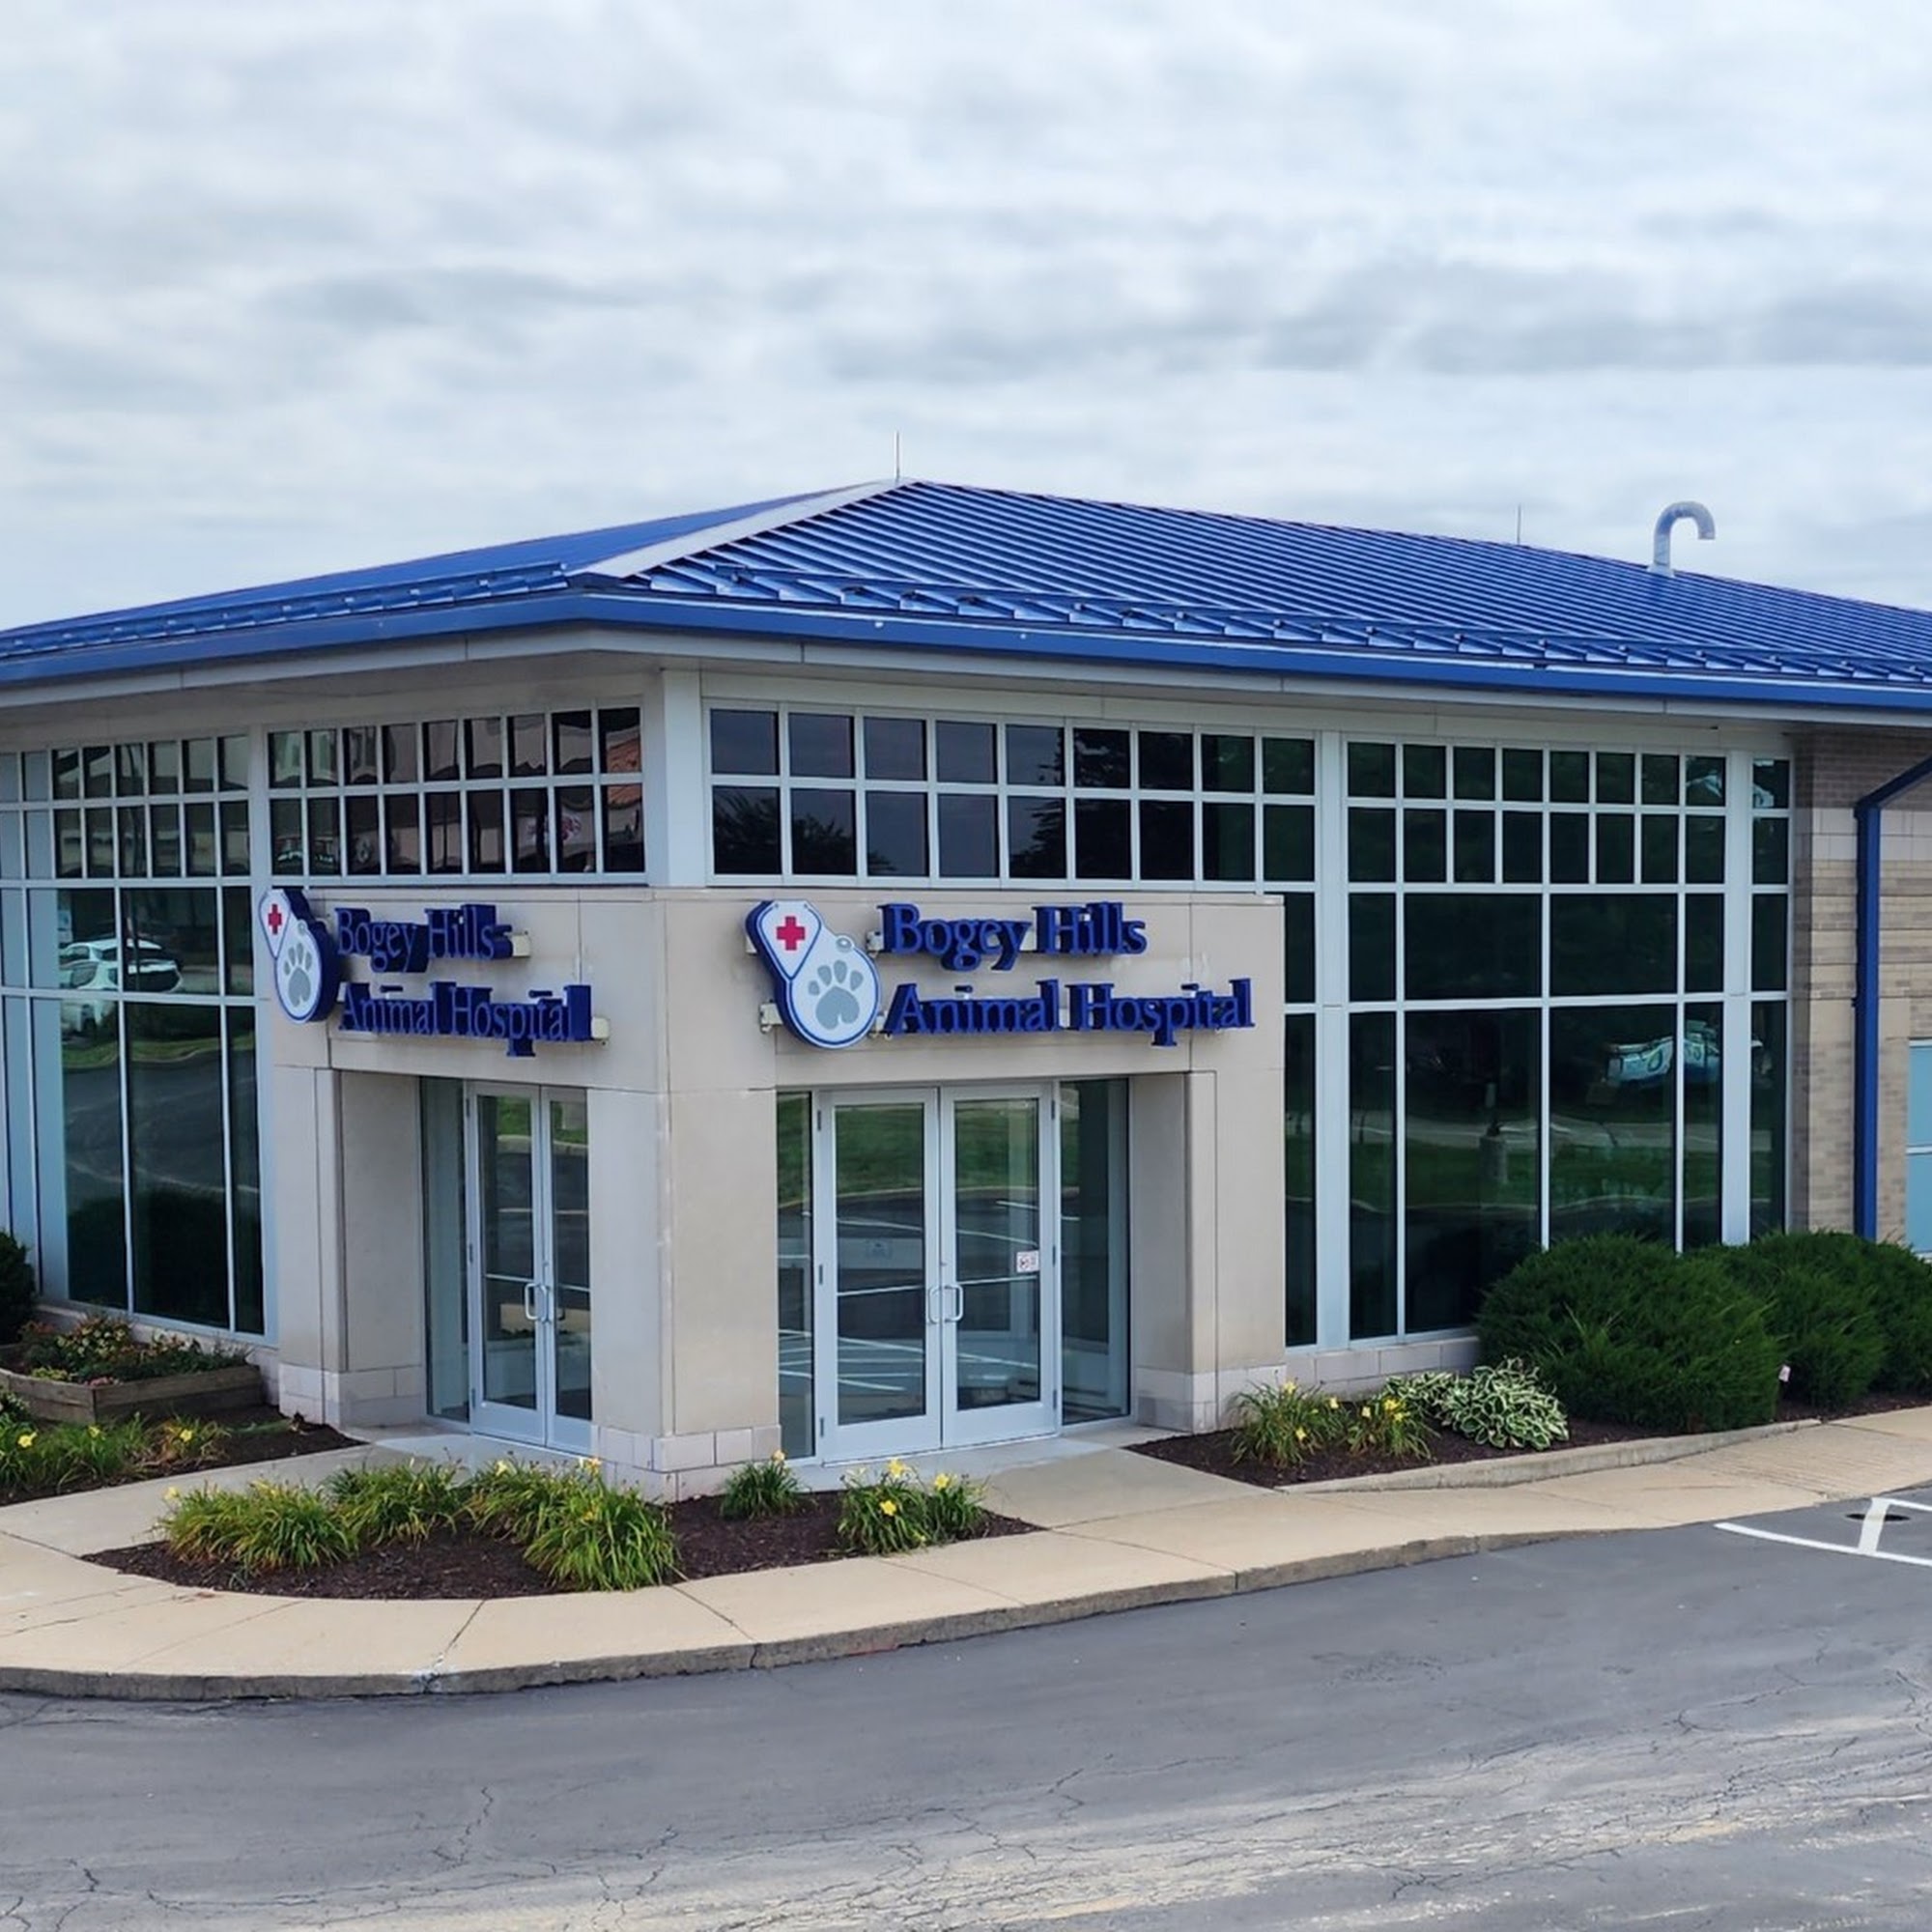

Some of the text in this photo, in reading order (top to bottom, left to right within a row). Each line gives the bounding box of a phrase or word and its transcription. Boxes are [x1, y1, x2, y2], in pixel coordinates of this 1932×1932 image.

[335, 904, 512, 973] Bogey Hills
[877, 901, 1148, 971] Bogey Hills
[339, 981, 591, 1057] Animal Hospital
[881, 978, 1255, 1047] Animal Hospital
